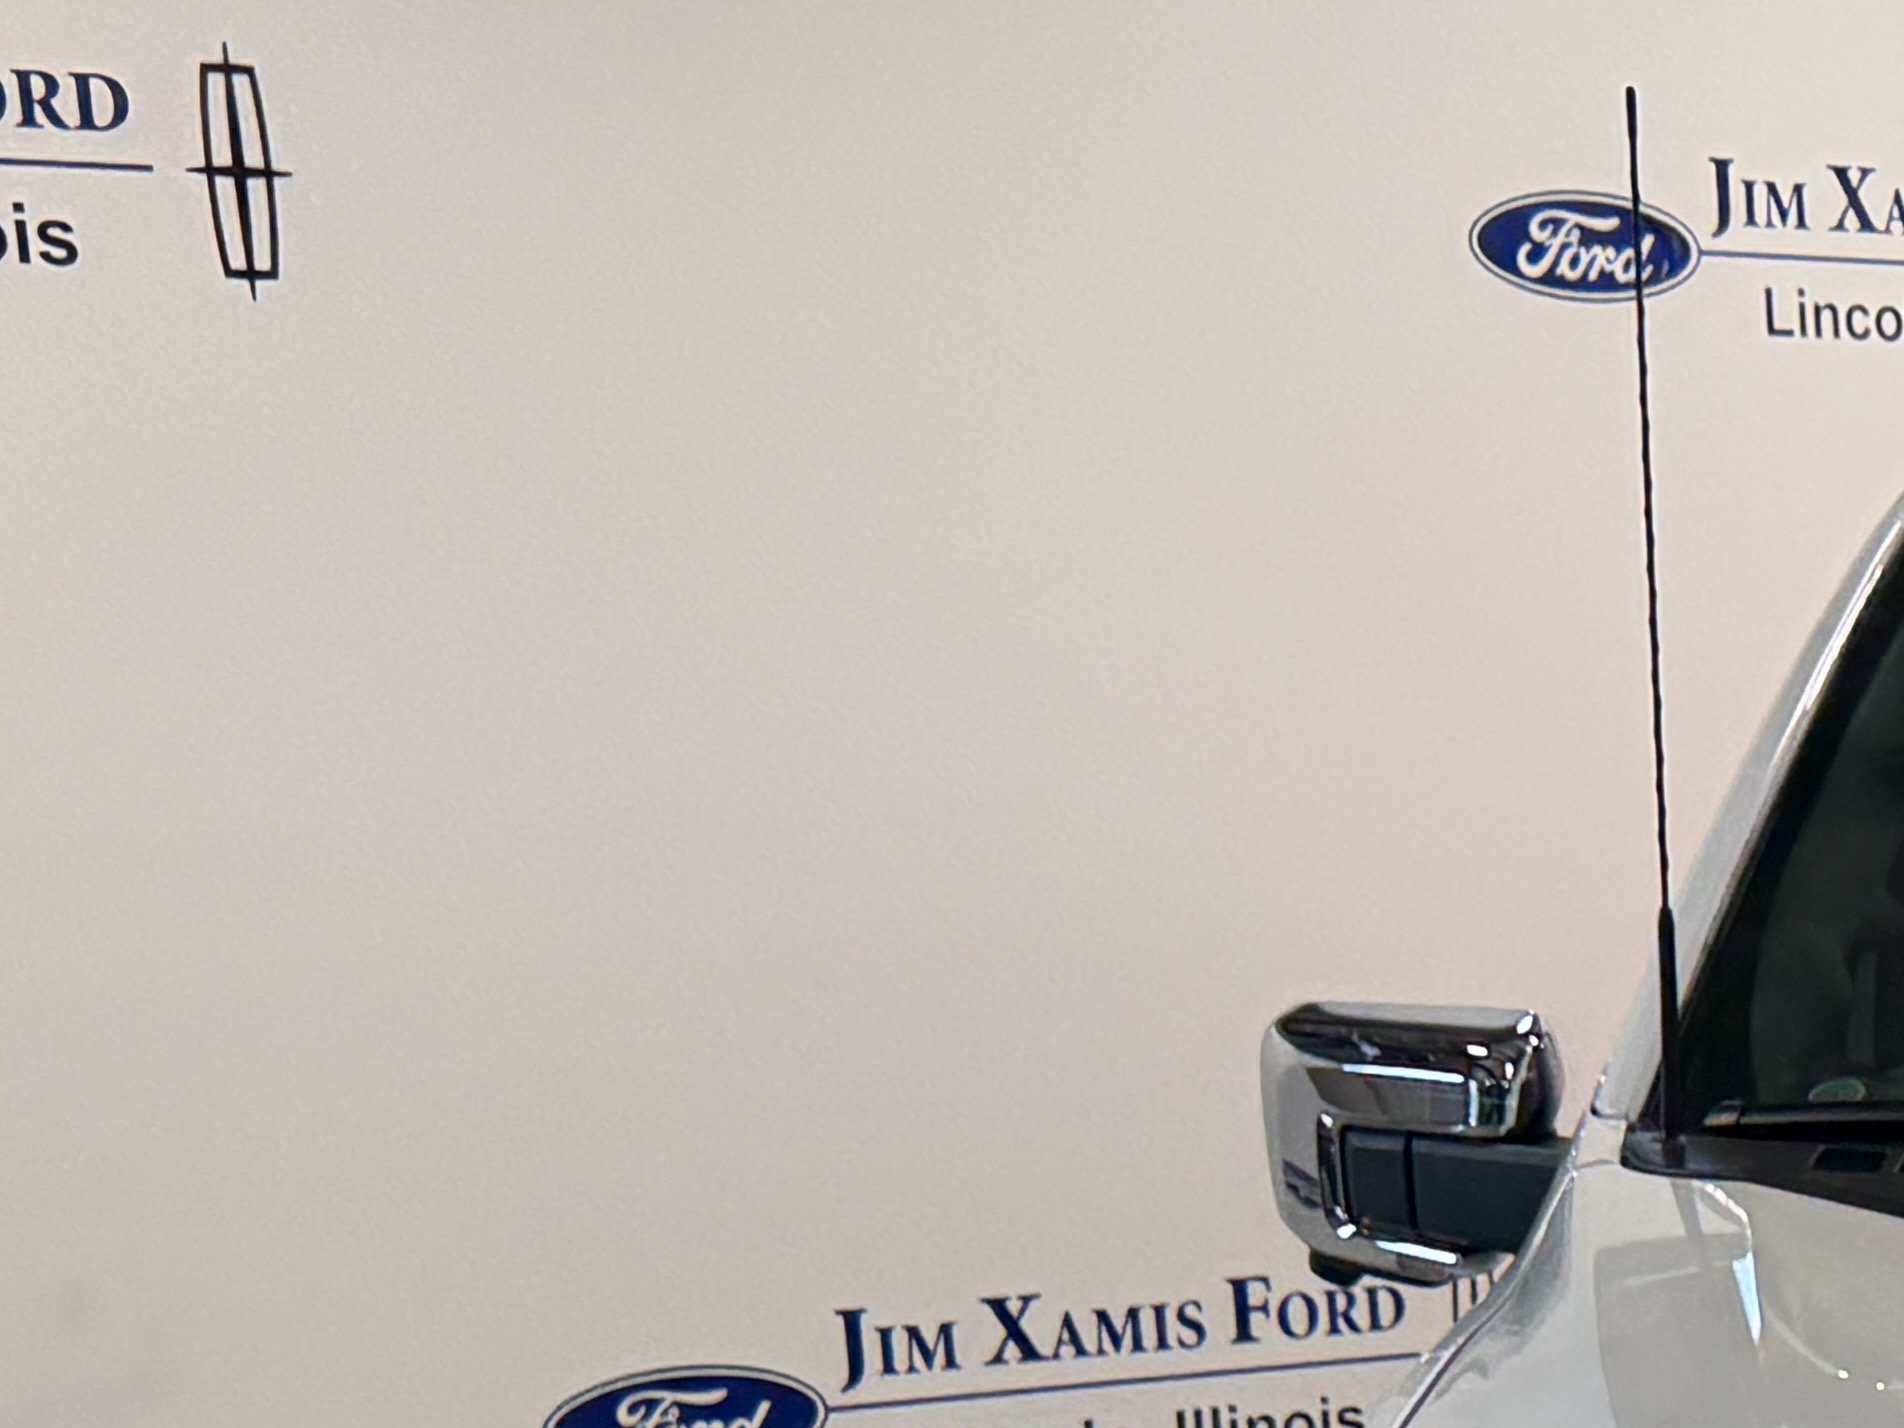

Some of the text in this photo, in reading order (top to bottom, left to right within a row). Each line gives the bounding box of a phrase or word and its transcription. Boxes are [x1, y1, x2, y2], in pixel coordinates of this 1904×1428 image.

[1708, 156, 1809, 239] JIM
[1516, 208, 1656, 285] Ford
[833, 1275, 1406, 1394] JIM XAMIS FORD
